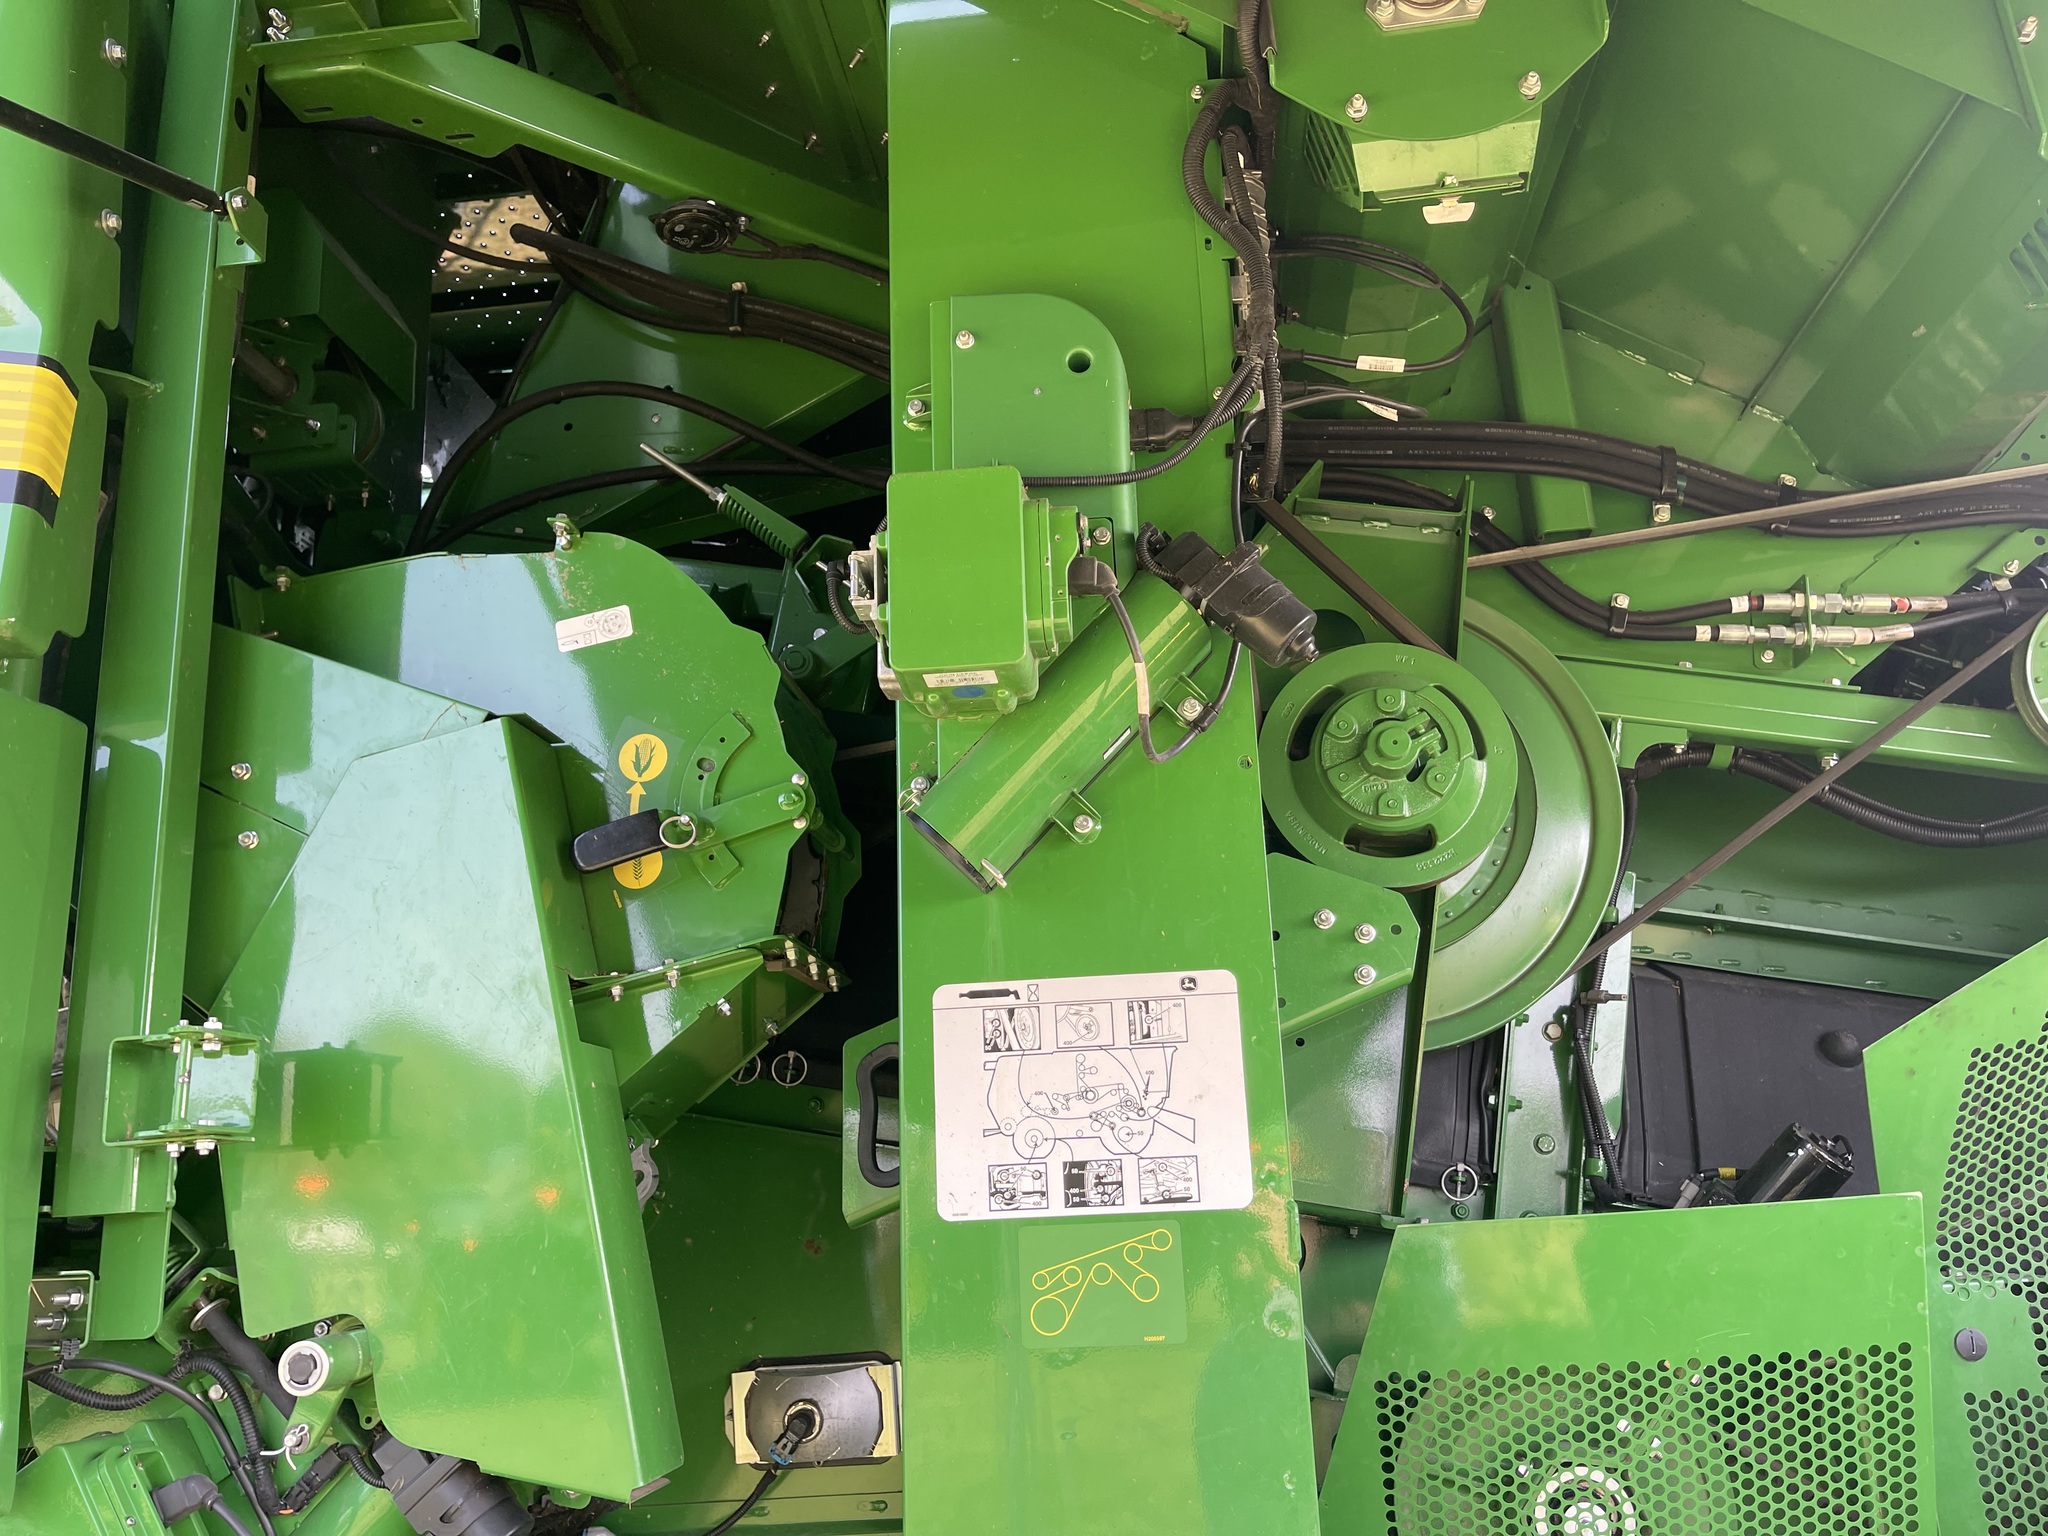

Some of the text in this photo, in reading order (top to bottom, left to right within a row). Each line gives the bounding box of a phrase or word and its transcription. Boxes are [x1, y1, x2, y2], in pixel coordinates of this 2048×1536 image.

[1285, 810, 1328, 855] MADE IN USA
